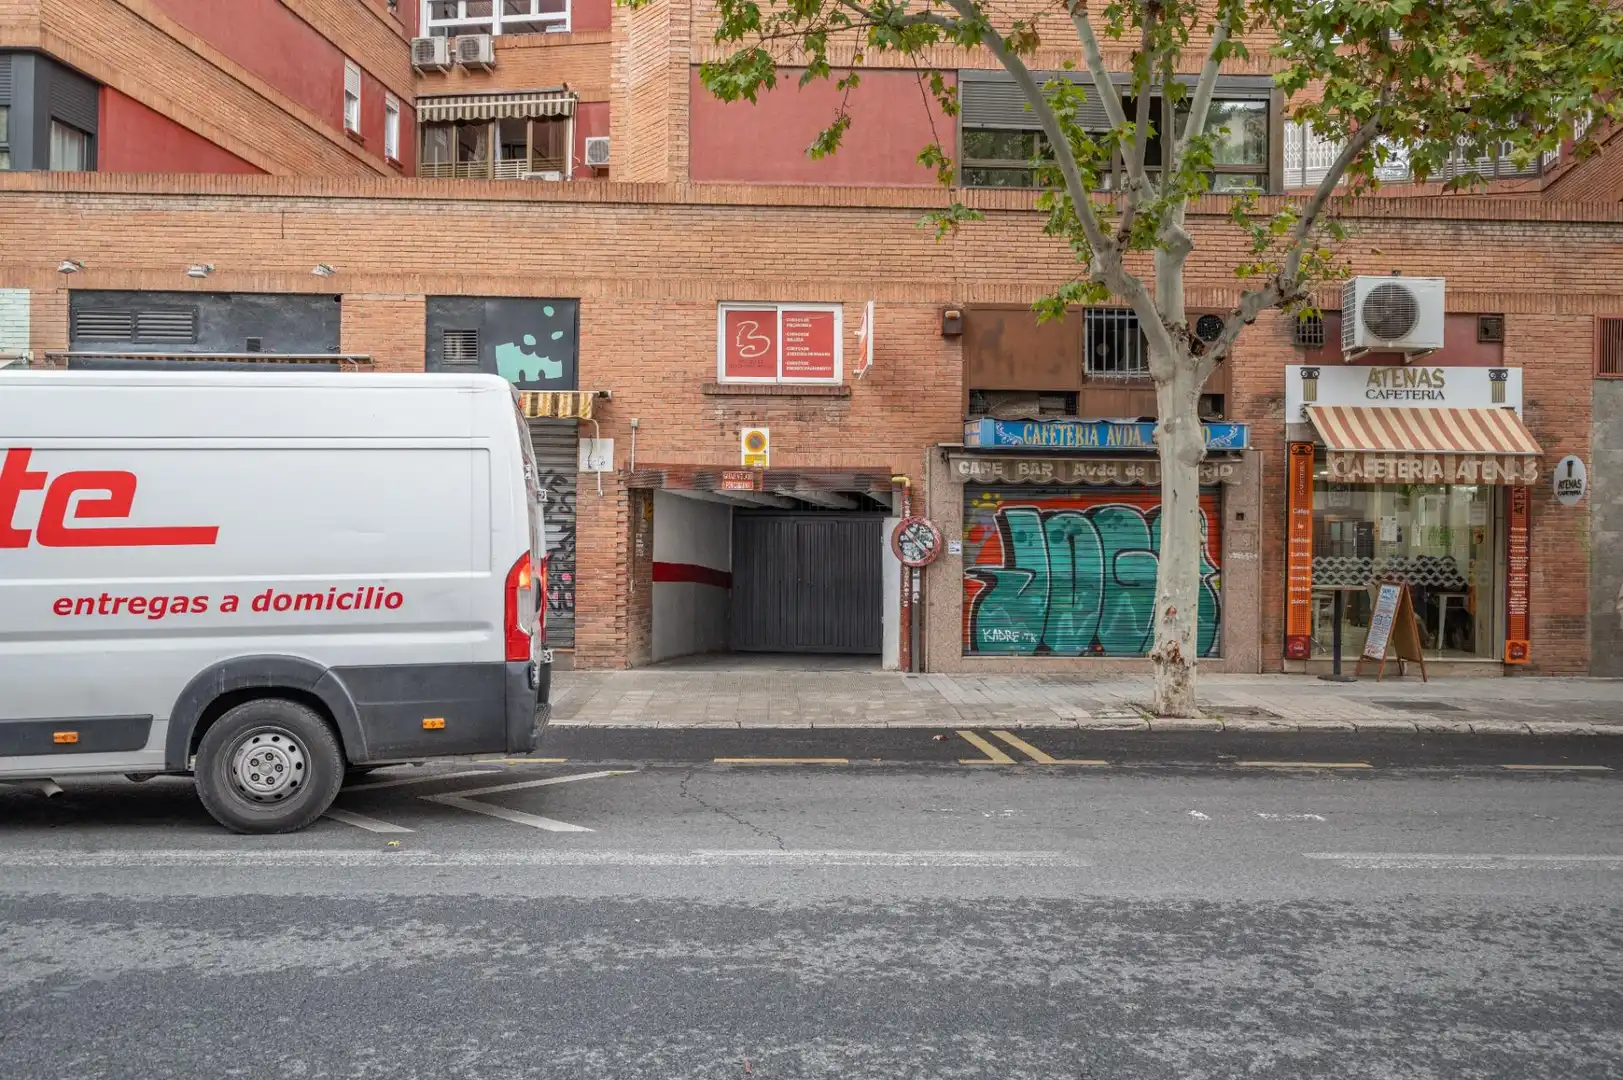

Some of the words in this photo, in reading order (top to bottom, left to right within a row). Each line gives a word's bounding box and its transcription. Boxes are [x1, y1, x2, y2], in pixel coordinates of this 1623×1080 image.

[1366, 367, 1446, 388] ATENAS
[1365, 389, 1446, 400] CAFETERIA
[1023, 423, 1100, 447] CAFETERIA
[1018, 462, 1053, 477] BAR
[1072, 462, 1117, 477] Avda
[1125, 463, 1145, 477] de
[1332, 457, 1444, 479] CAFETERIA
[1456, 458, 1539, 481] ATENAS
[1558, 479, 1582, 489] ATENAS
[52, 591, 208, 619] entregas
[220, 595, 239, 612] a
[252, 586, 403, 612] domicilio
[982, 628, 1020, 642] KADRE
